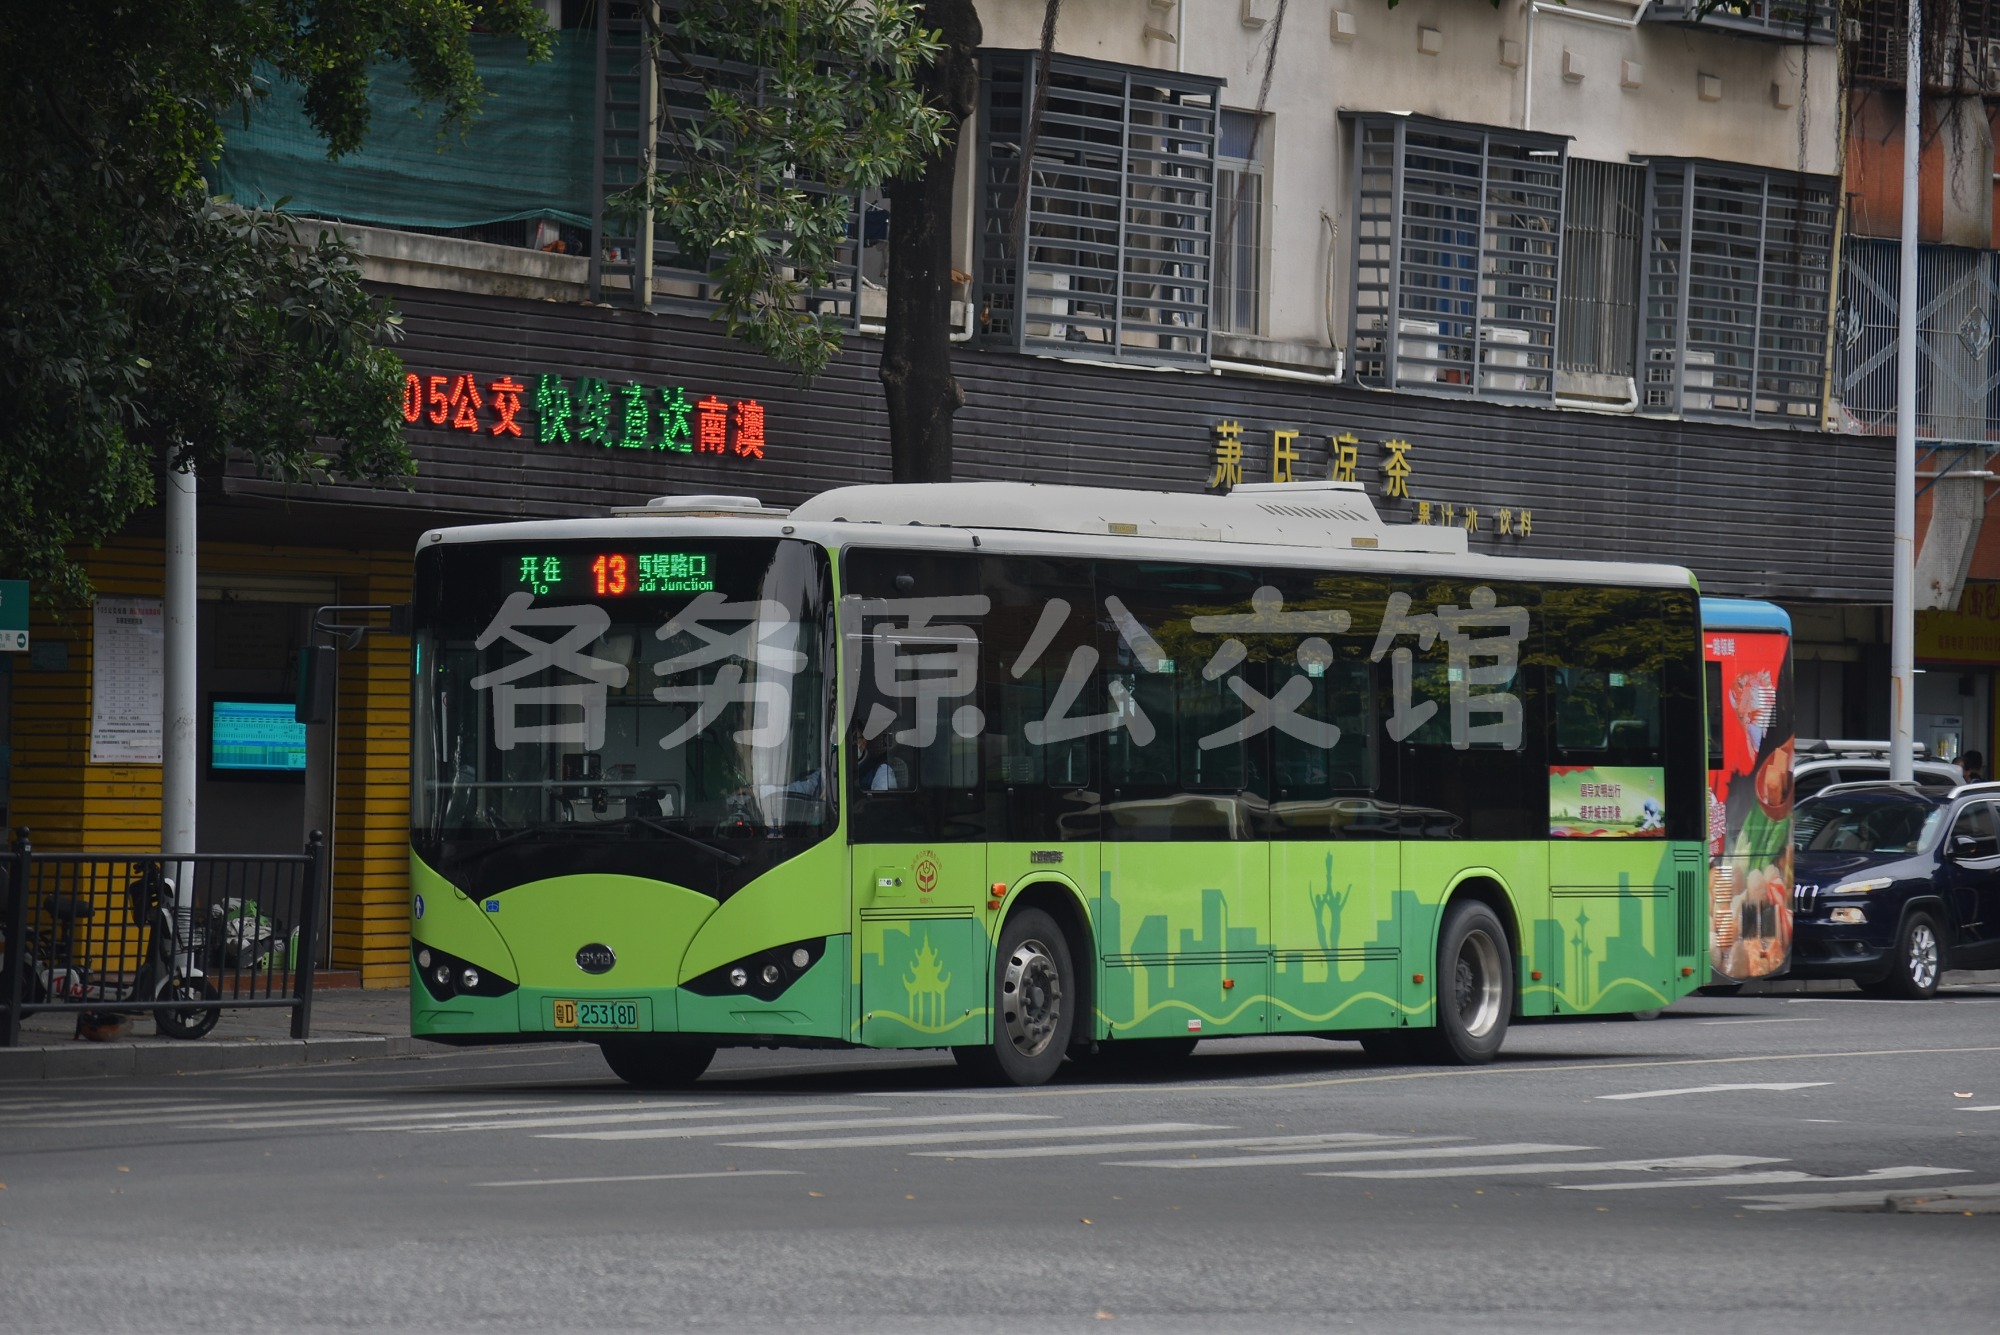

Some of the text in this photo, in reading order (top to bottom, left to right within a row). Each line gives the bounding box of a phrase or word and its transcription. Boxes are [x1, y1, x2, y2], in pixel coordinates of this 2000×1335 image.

[519, 556, 562, 582] 开往
[593, 555, 626, 595] 13
[531, 581, 549, 594] To
[661, 578, 713, 591] Junction
[1580, 784, 1621, 798] 倡导文明出行
[1580, 805, 1621, 820] 提升城市形象
[580, 952, 611, 965] BYD
